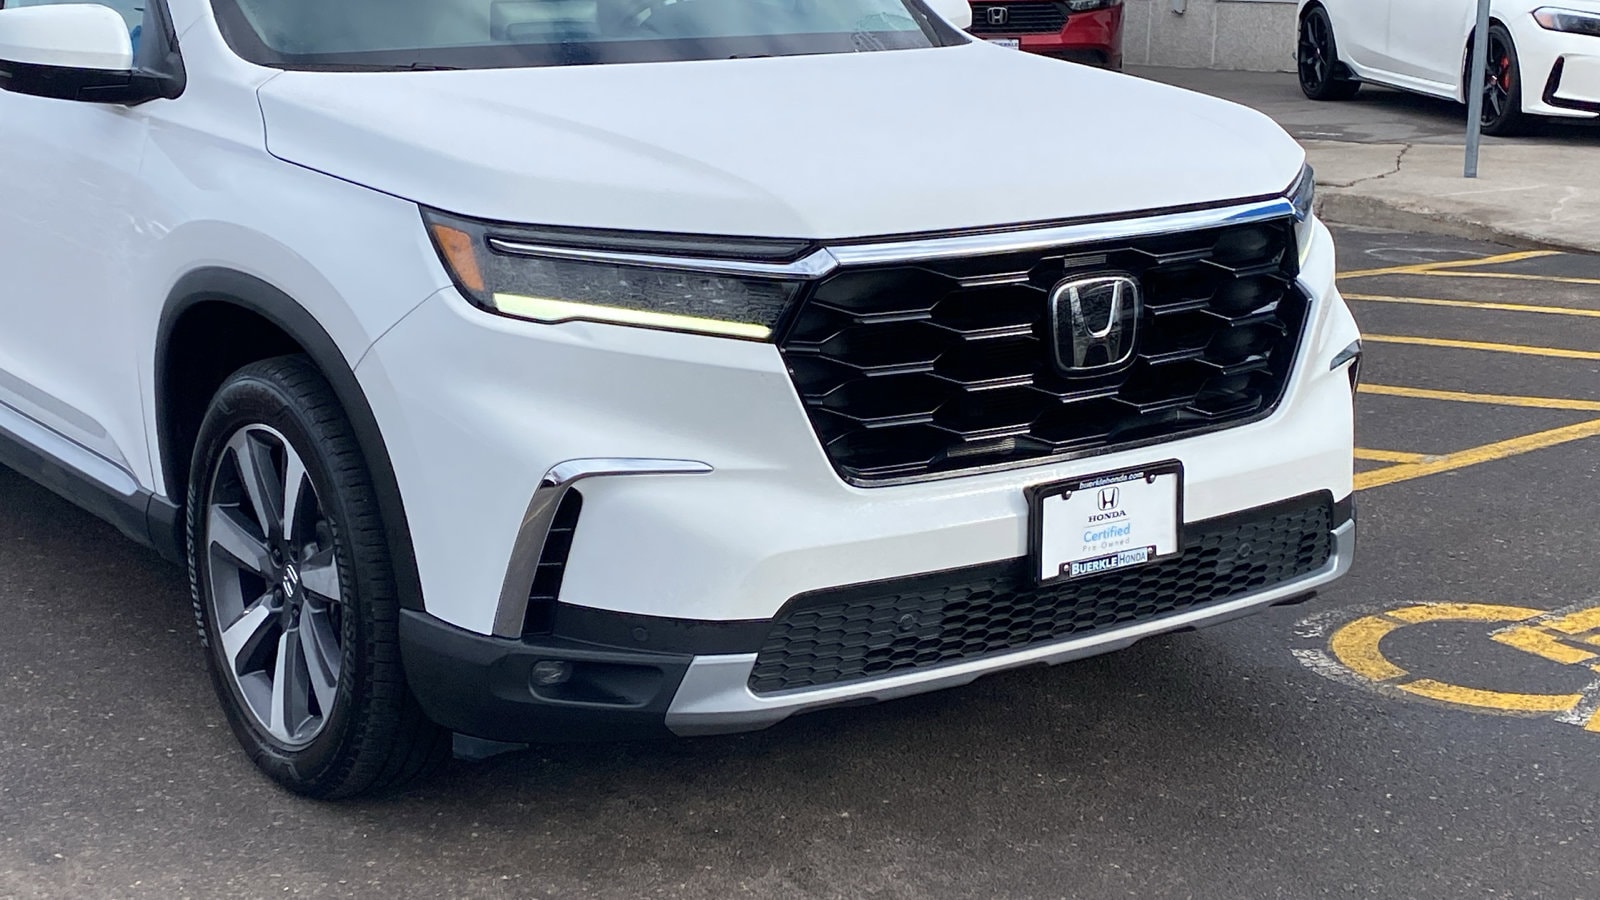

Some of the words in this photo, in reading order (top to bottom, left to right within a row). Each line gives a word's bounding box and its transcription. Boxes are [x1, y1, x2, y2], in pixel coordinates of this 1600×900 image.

[1088, 510, 1126, 523] HONDA
[1083, 523, 1131, 543] Certified
[1100, 538, 1130, 550] Owned
[1071, 556, 1117, 575] BUERKLE
[1118, 551, 1146, 565] HONDA
